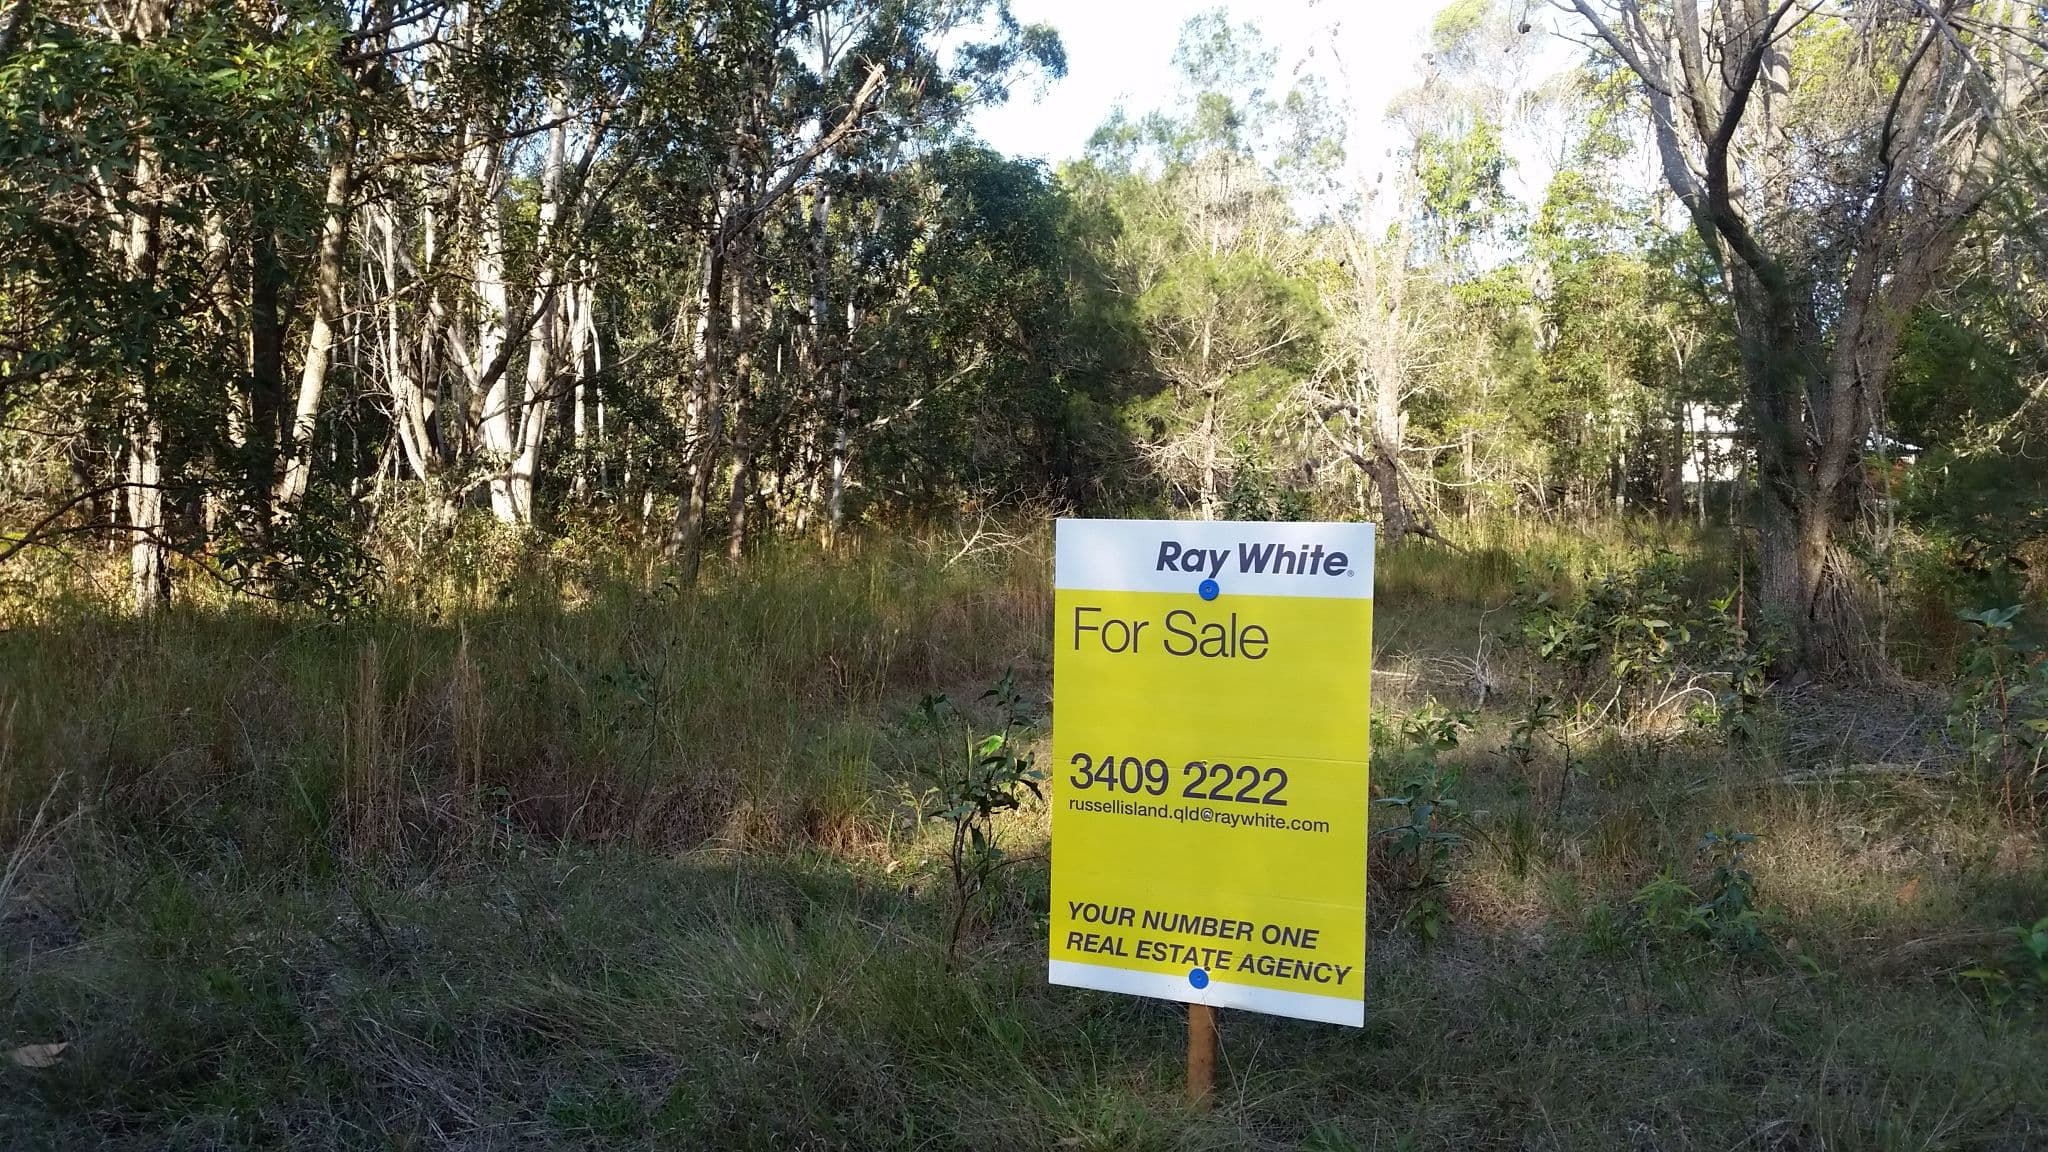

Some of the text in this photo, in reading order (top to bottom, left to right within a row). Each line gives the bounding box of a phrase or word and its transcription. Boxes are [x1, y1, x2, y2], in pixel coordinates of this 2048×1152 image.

[1156, 541, 1231, 579] Ray
[1073, 606, 1269, 660] For Sale
[1070, 753, 1288, 806] 3409 2222
[1069, 799, 1330, 833] russellisland.qld@raywhite.com
[1068, 901, 1320, 949] YOUR NUMBER ONE
[1066, 931, 1353, 985] REAL ESTATE AGENCY
